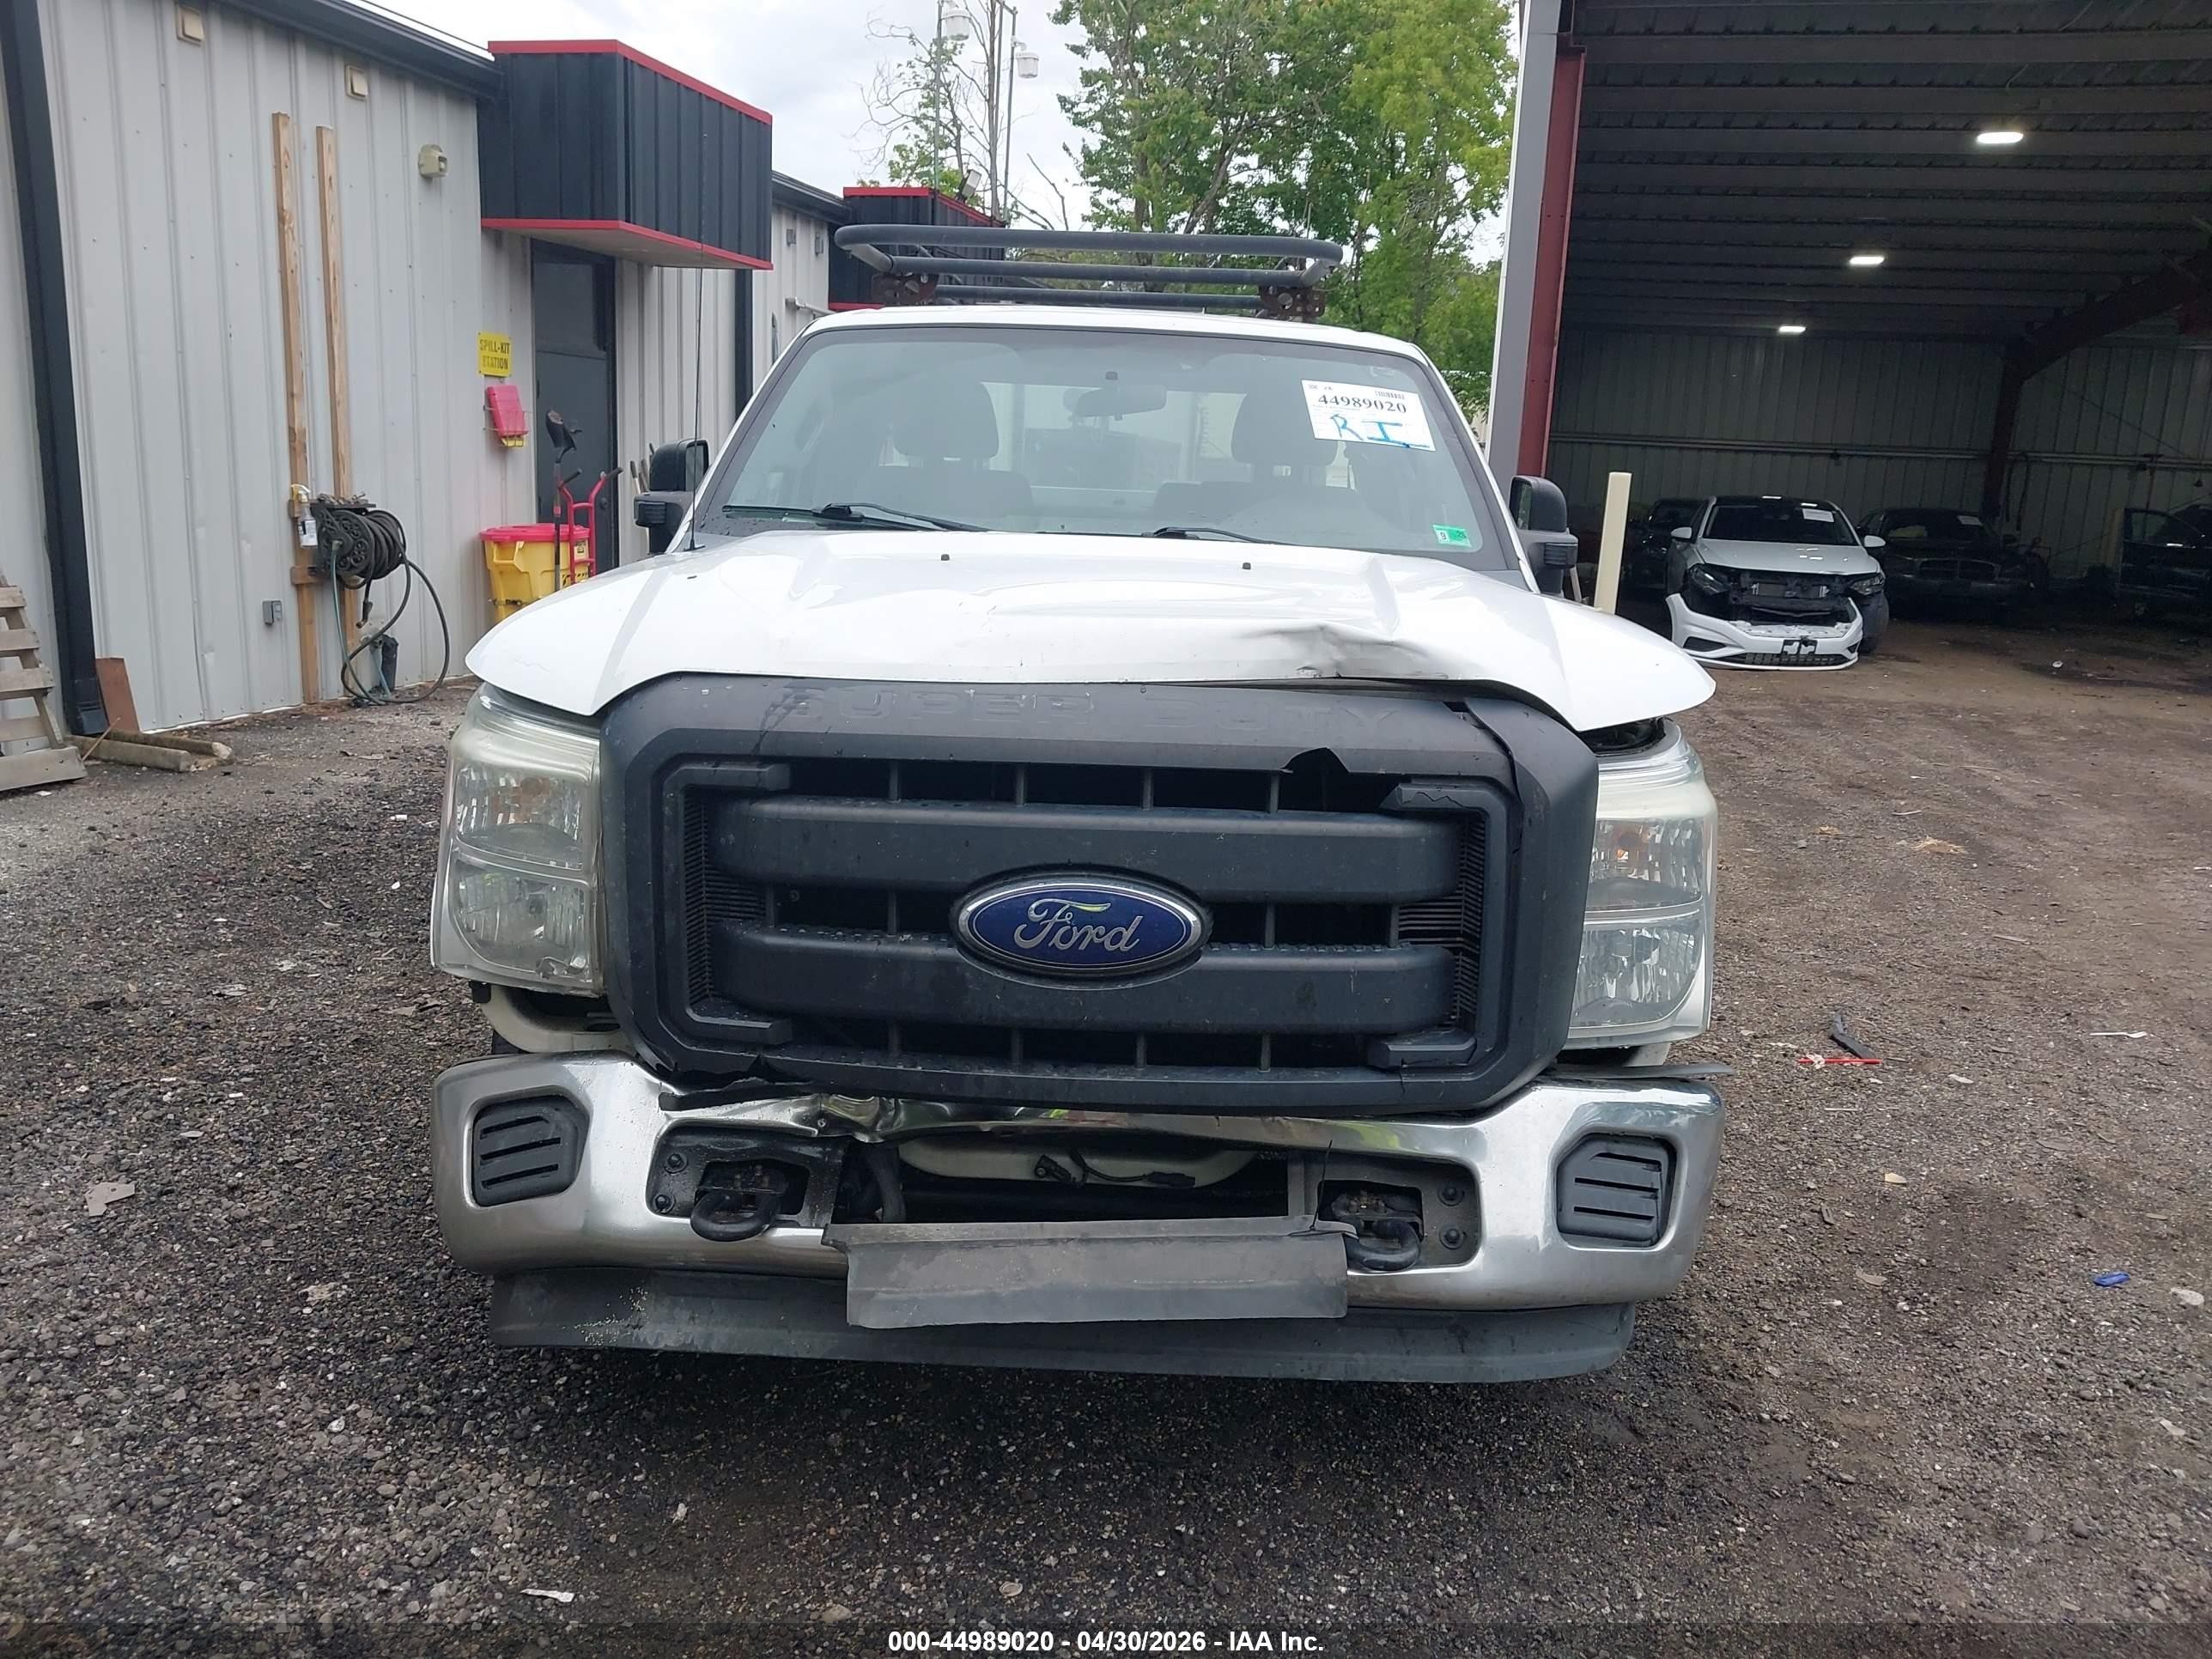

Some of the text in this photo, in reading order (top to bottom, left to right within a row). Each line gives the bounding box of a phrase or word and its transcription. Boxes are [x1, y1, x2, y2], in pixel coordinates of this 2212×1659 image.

[479, 338, 510, 355] SPILL-KIT
[482, 355, 509, 370] STATION
[1318, 393, 1407, 414] 44989020
[784, 687, 1400, 735] SUPER DUTY
[1013, 898, 1144, 952] Ford
